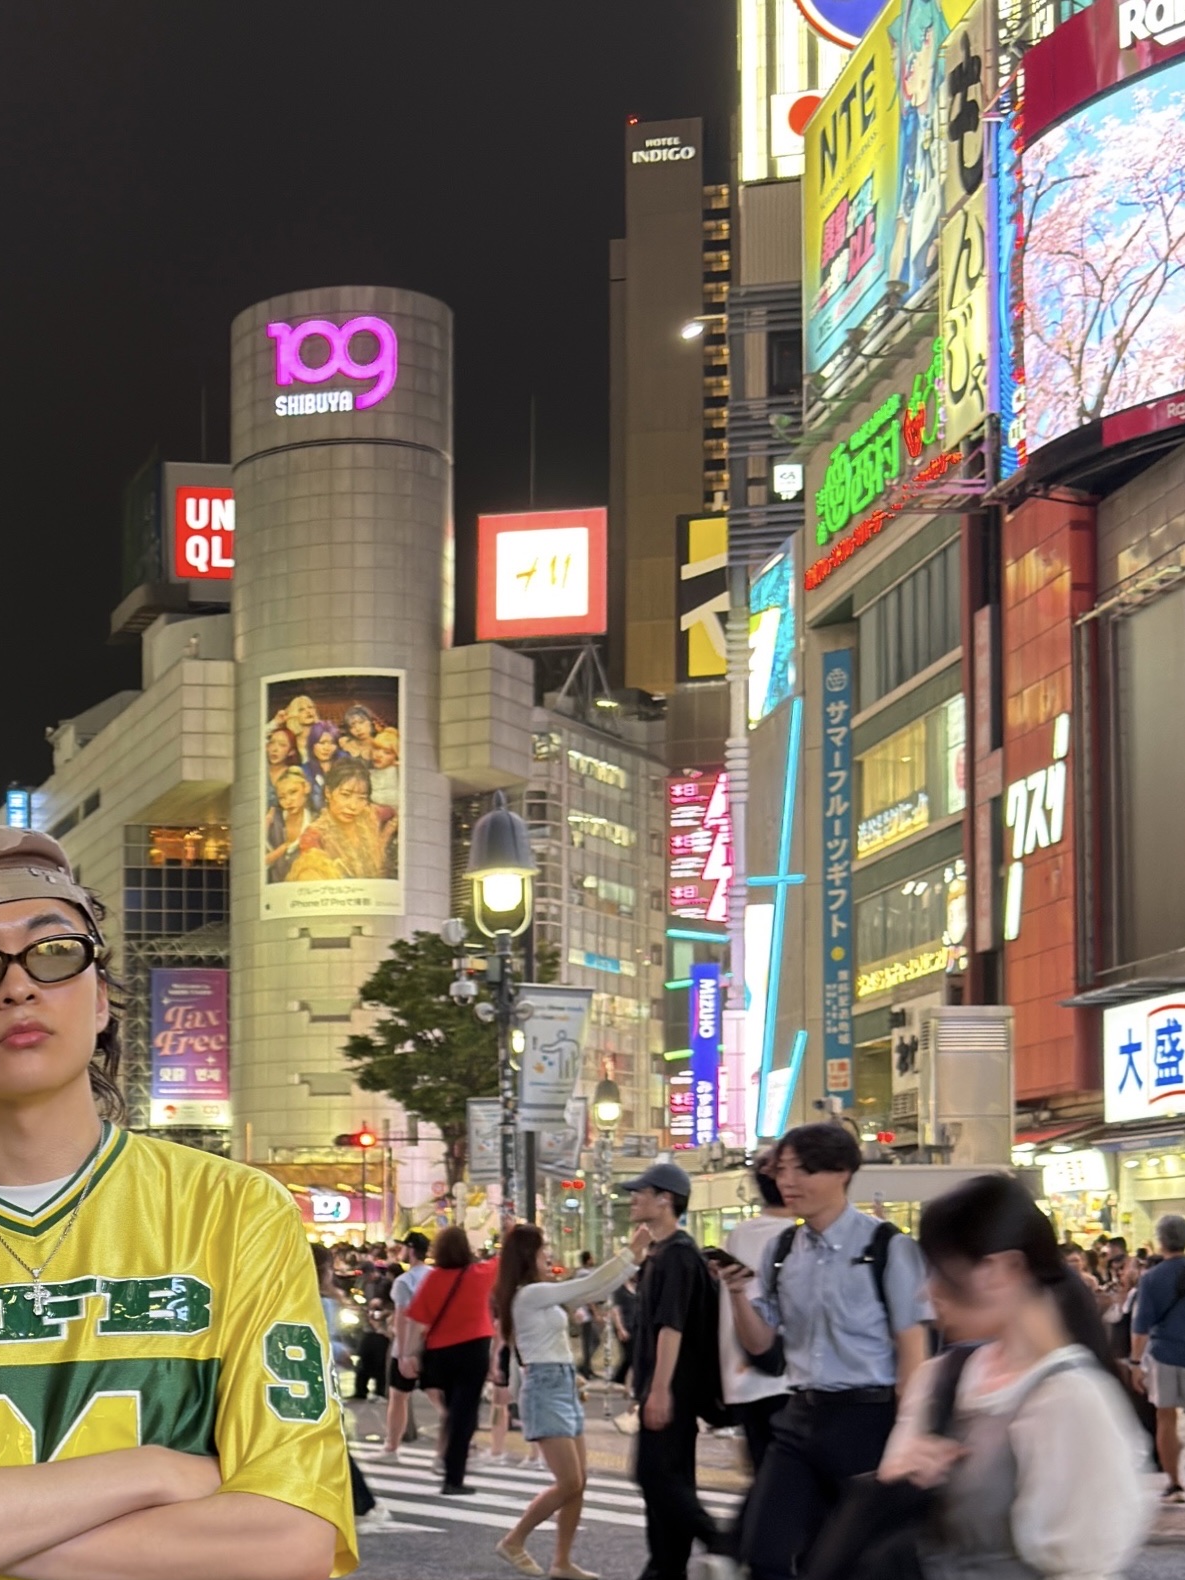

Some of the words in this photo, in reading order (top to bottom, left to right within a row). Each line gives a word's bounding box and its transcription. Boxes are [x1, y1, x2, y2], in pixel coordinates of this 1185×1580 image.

[632, 146, 696, 163] INDIGO
[645, 136, 681, 148] HOTEL
[947, 40, 985, 410] もんじゃ
[267, 316, 399, 411] 109
[275, 390, 354, 418] SHIBUYA
[185, 498, 235, 532] UN
[185, 534, 235, 574] QL
[826, 699, 850, 938] サマーフルーツギフト
[1006, 760, 1066, 860] クスリ
[164, 1005, 221, 1031] Tax
[698, 978, 717, 1039] MIZUHO
[154, 1029, 226, 1057] Free
[1119, 1017, 1185, 1095] 大盛
[262, 1321, 329, 1425] 9
